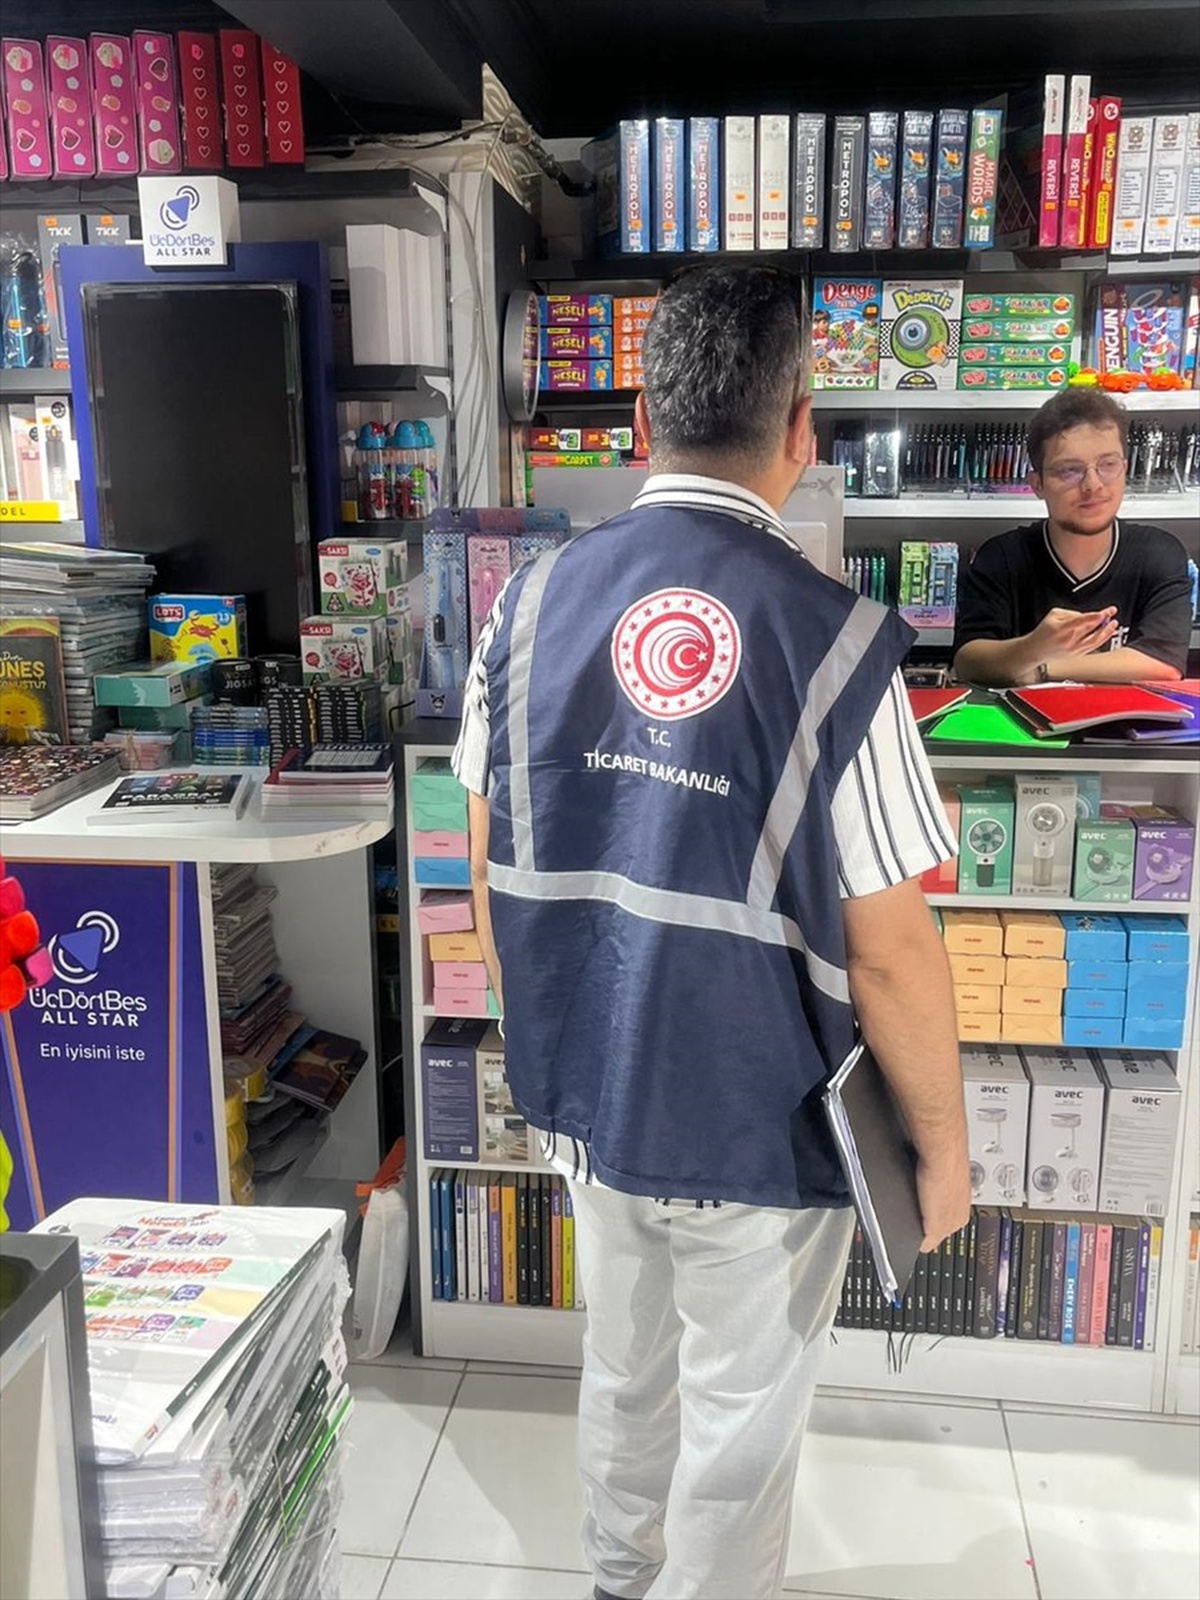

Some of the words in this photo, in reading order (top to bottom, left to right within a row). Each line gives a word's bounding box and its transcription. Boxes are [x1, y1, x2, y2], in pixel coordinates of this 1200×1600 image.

[806, 137, 817, 212] METROPOL
[840, 141, 851, 217] METROPOL
[970, 154, 986, 205] WORDS
[984, 160, 996, 197] MAGIC
[47, 226, 72, 236] TKK
[95, 226, 120, 236] TKK
[156, 247, 178, 256] ALL
[182, 247, 211, 256] STAR
[1104, 308, 1120, 371] ENGUIN
[647, 727, 672, 748] T.C.
[583, 748, 648, 775] TİCARET
[649, 761, 731, 797] BAKANLIĞI
[1021, 786, 1050, 796] avec
[965, 806, 990, 815] avec
[1080, 831, 1107, 840] avec
[1140, 830, 1167, 840] avec
[42, 1011, 78, 1025] ALL
[87, 1012, 139, 1027] STAR
[40, 1043, 61, 1057] En
[65, 1043, 111, 1061] iyisini
[115, 1045, 145, 1060] iste
[428, 1058, 453, 1068] avec
[980, 1084, 1010, 1094] avec
[1054, 1089, 1085, 1099] avec
[1131, 1094, 1161, 1105] avec
[1065, 1278, 1075, 1305] EMERY
[1064, 1306, 1074, 1329] ROSE
